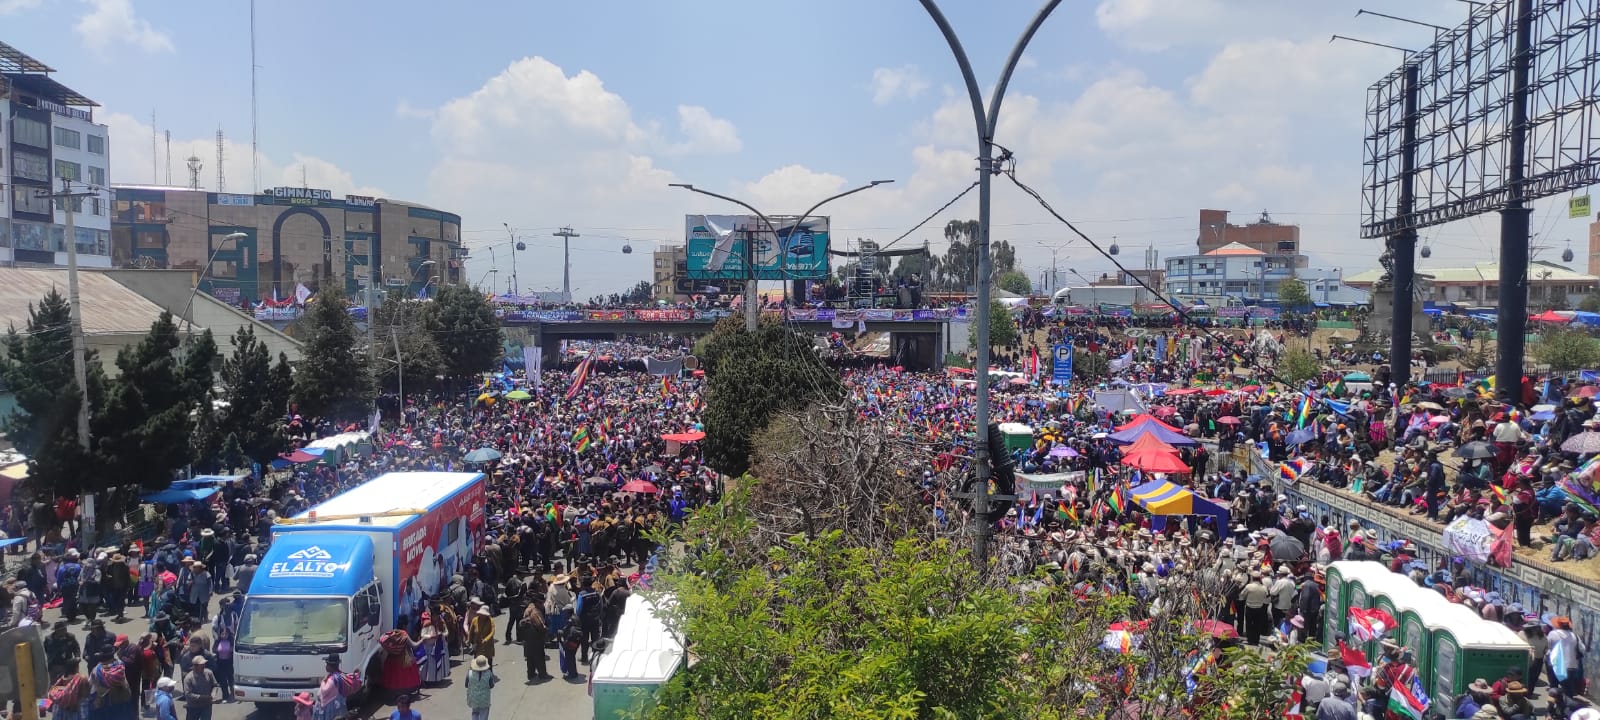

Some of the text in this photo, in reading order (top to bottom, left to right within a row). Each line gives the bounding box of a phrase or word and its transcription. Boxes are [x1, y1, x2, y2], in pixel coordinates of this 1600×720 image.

[274, 187, 331, 200] GIMNASIO
[1059, 347, 1069, 360] P
[270, 561, 337, 573] EL ALTO
